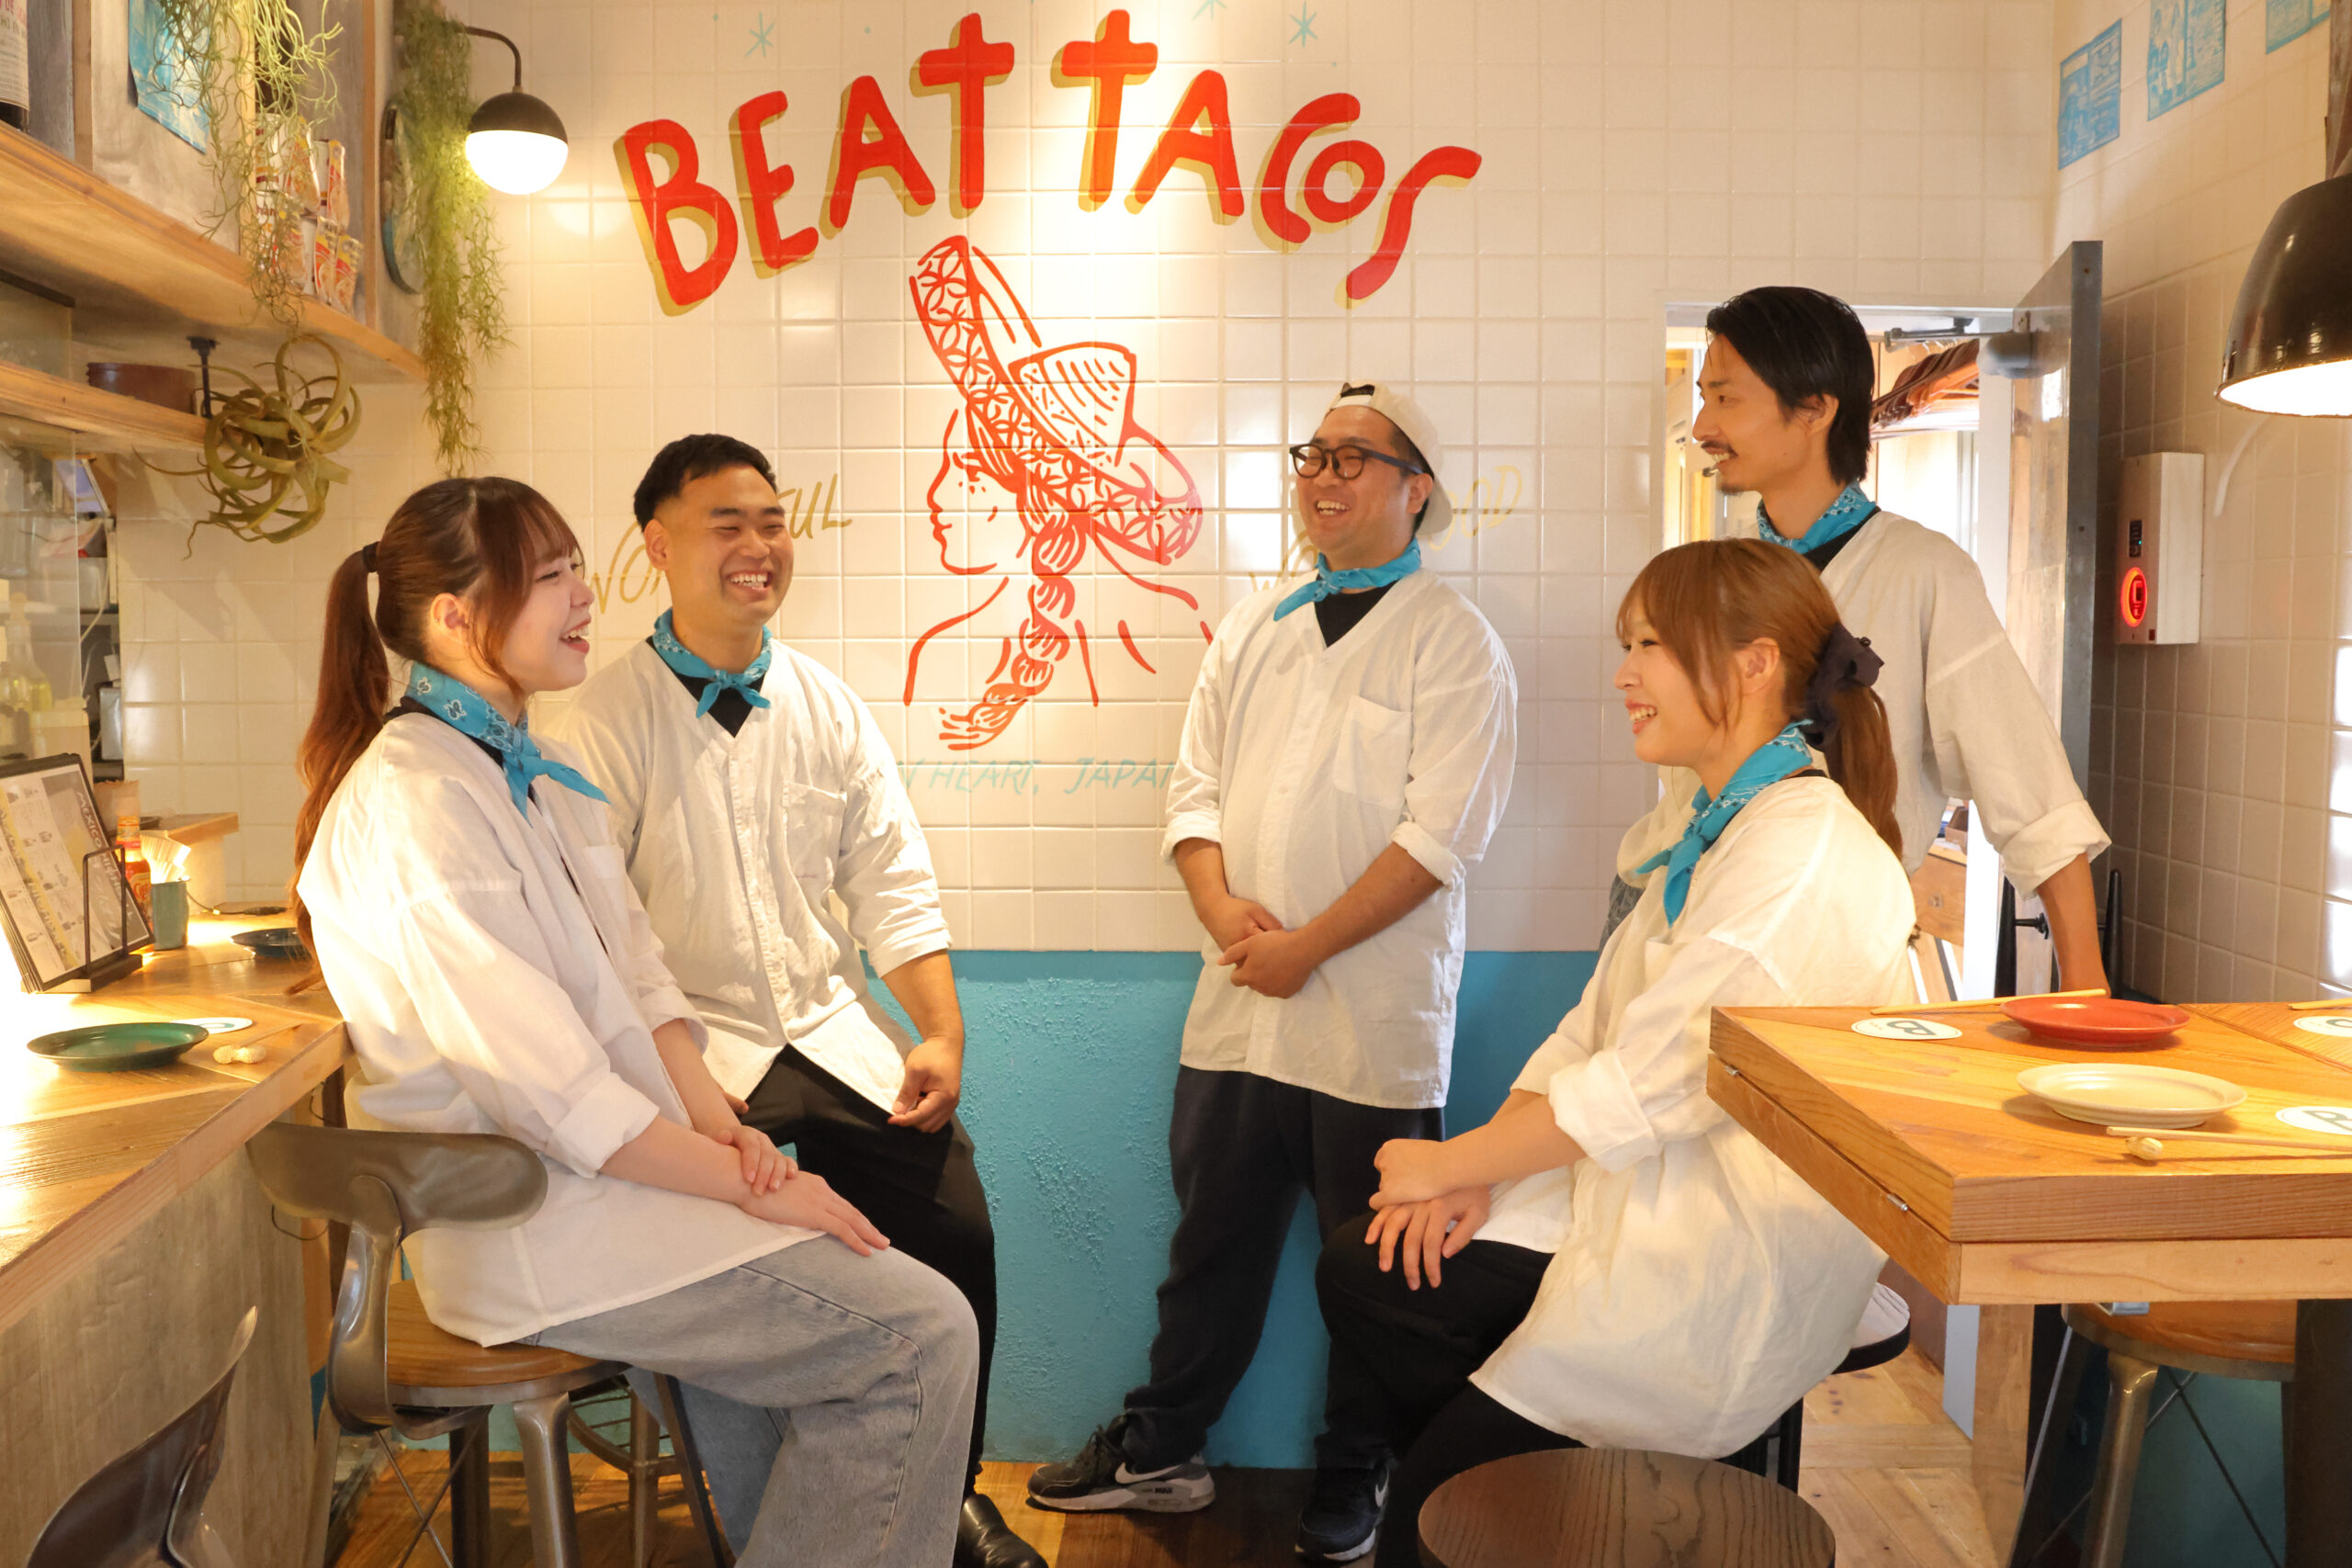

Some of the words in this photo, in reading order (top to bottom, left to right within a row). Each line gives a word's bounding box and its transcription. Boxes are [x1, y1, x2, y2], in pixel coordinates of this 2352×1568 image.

[613, 12, 1014, 316] BEAT
[1050, 9, 1483, 309] TACOS
[928, 759, 1042, 795] HEART,
[76, 790, 104, 850] MEXICO
